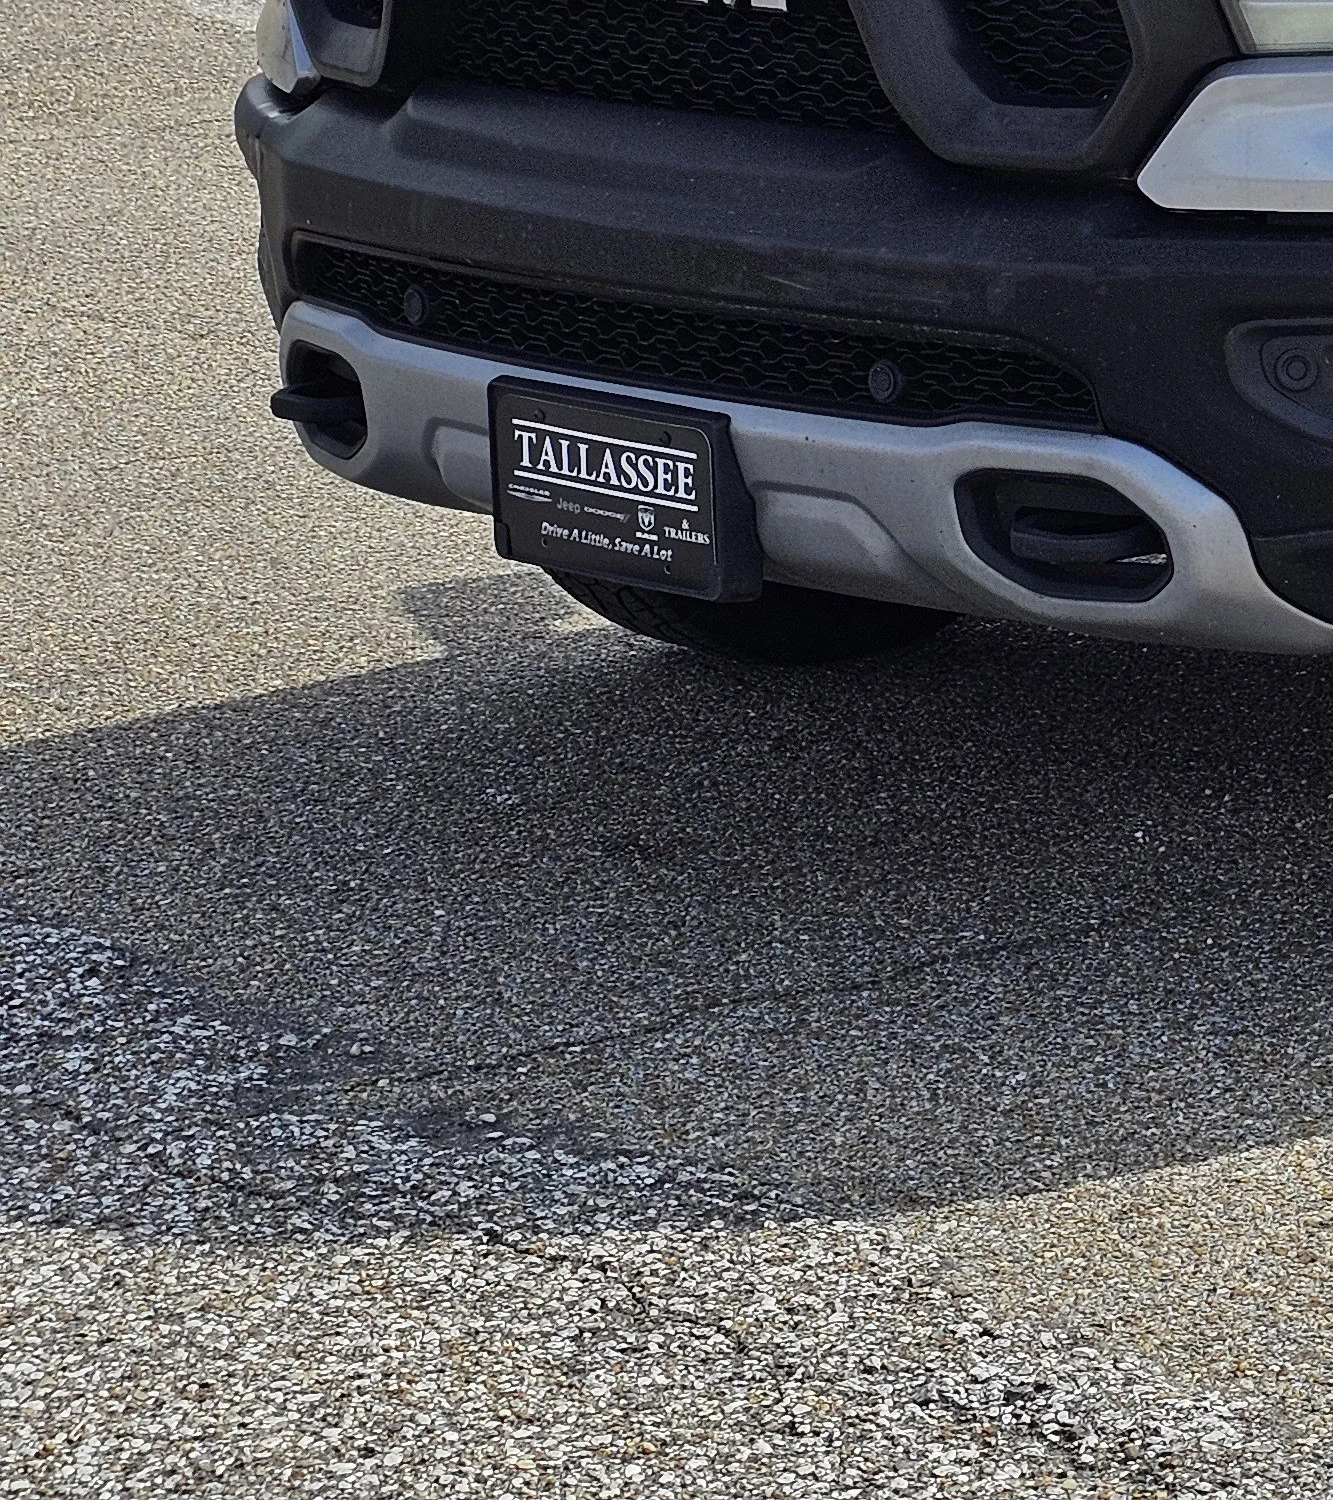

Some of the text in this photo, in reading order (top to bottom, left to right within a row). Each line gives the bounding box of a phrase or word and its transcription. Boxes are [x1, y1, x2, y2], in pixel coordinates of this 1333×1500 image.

[513, 429, 697, 501] TALLASSEE
[556, 498, 581, 514] Jeep
[681, 518, 690, 530] &
[541, 521, 673, 562] Drive A Little, Save A Lot
[663, 526, 710, 545] TRAILERS
